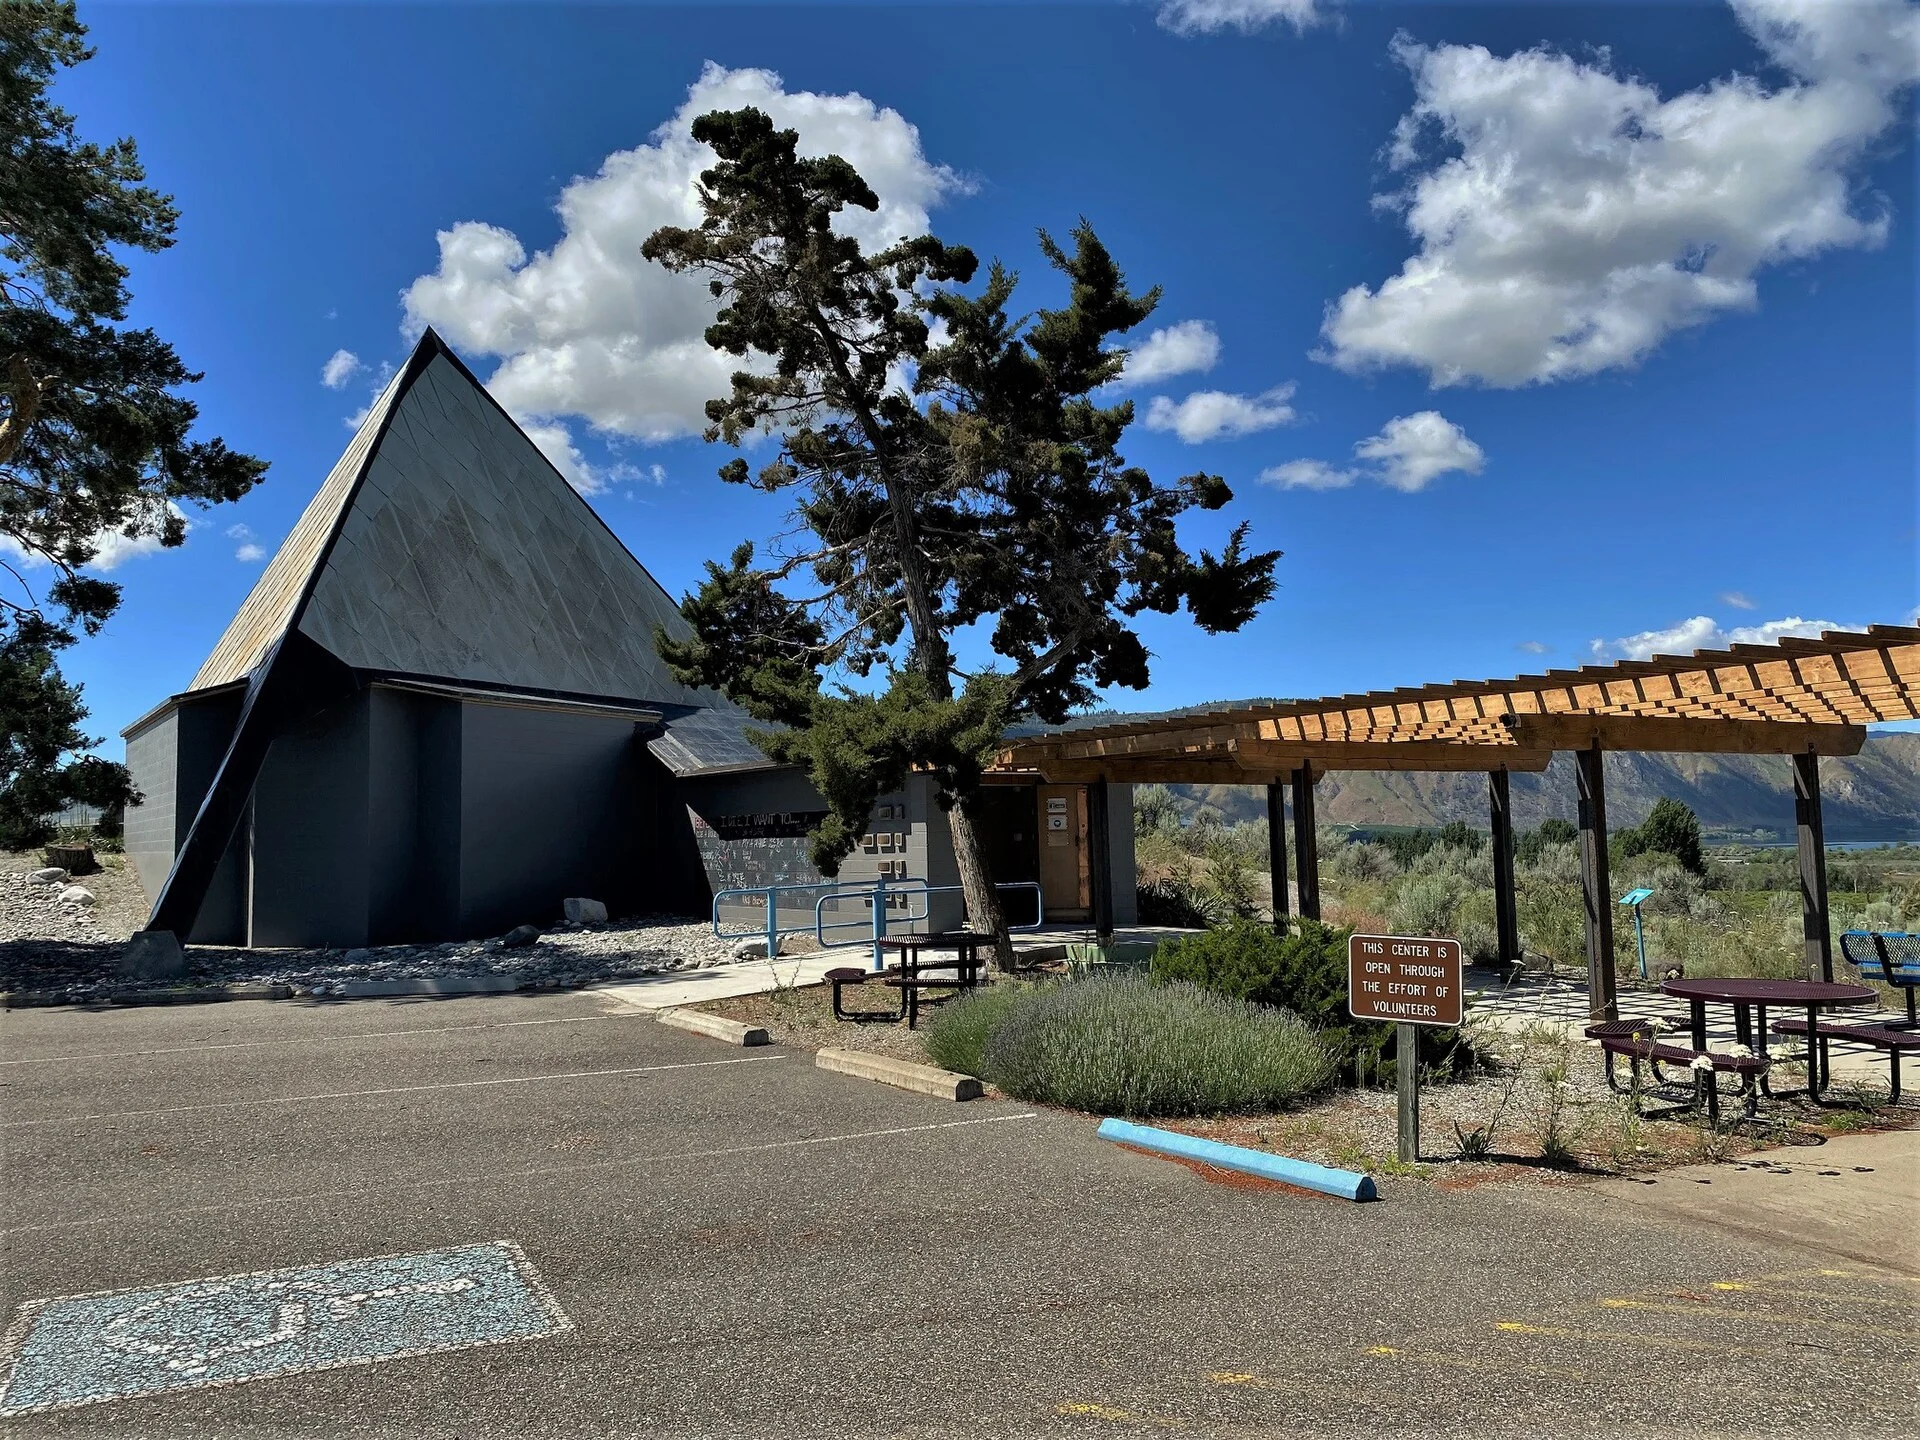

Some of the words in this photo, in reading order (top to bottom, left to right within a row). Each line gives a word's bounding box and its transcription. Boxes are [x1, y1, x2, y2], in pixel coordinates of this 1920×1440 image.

[753, 813, 775, 826] WANT
[1362, 942, 1384, 954] THIS
[1391, 944, 1429, 957] CENTER
[1437, 946, 1447, 958] IS
[1365, 961, 1391, 974] OPEN
[1399, 964, 1445, 978] THROUGH
[1362, 980, 1381, 993] THE
[1388, 982, 1427, 996] EFFORT
[1435, 985, 1449, 998] OF
[1373, 1000, 1437, 1016] VOLUNTEERS
